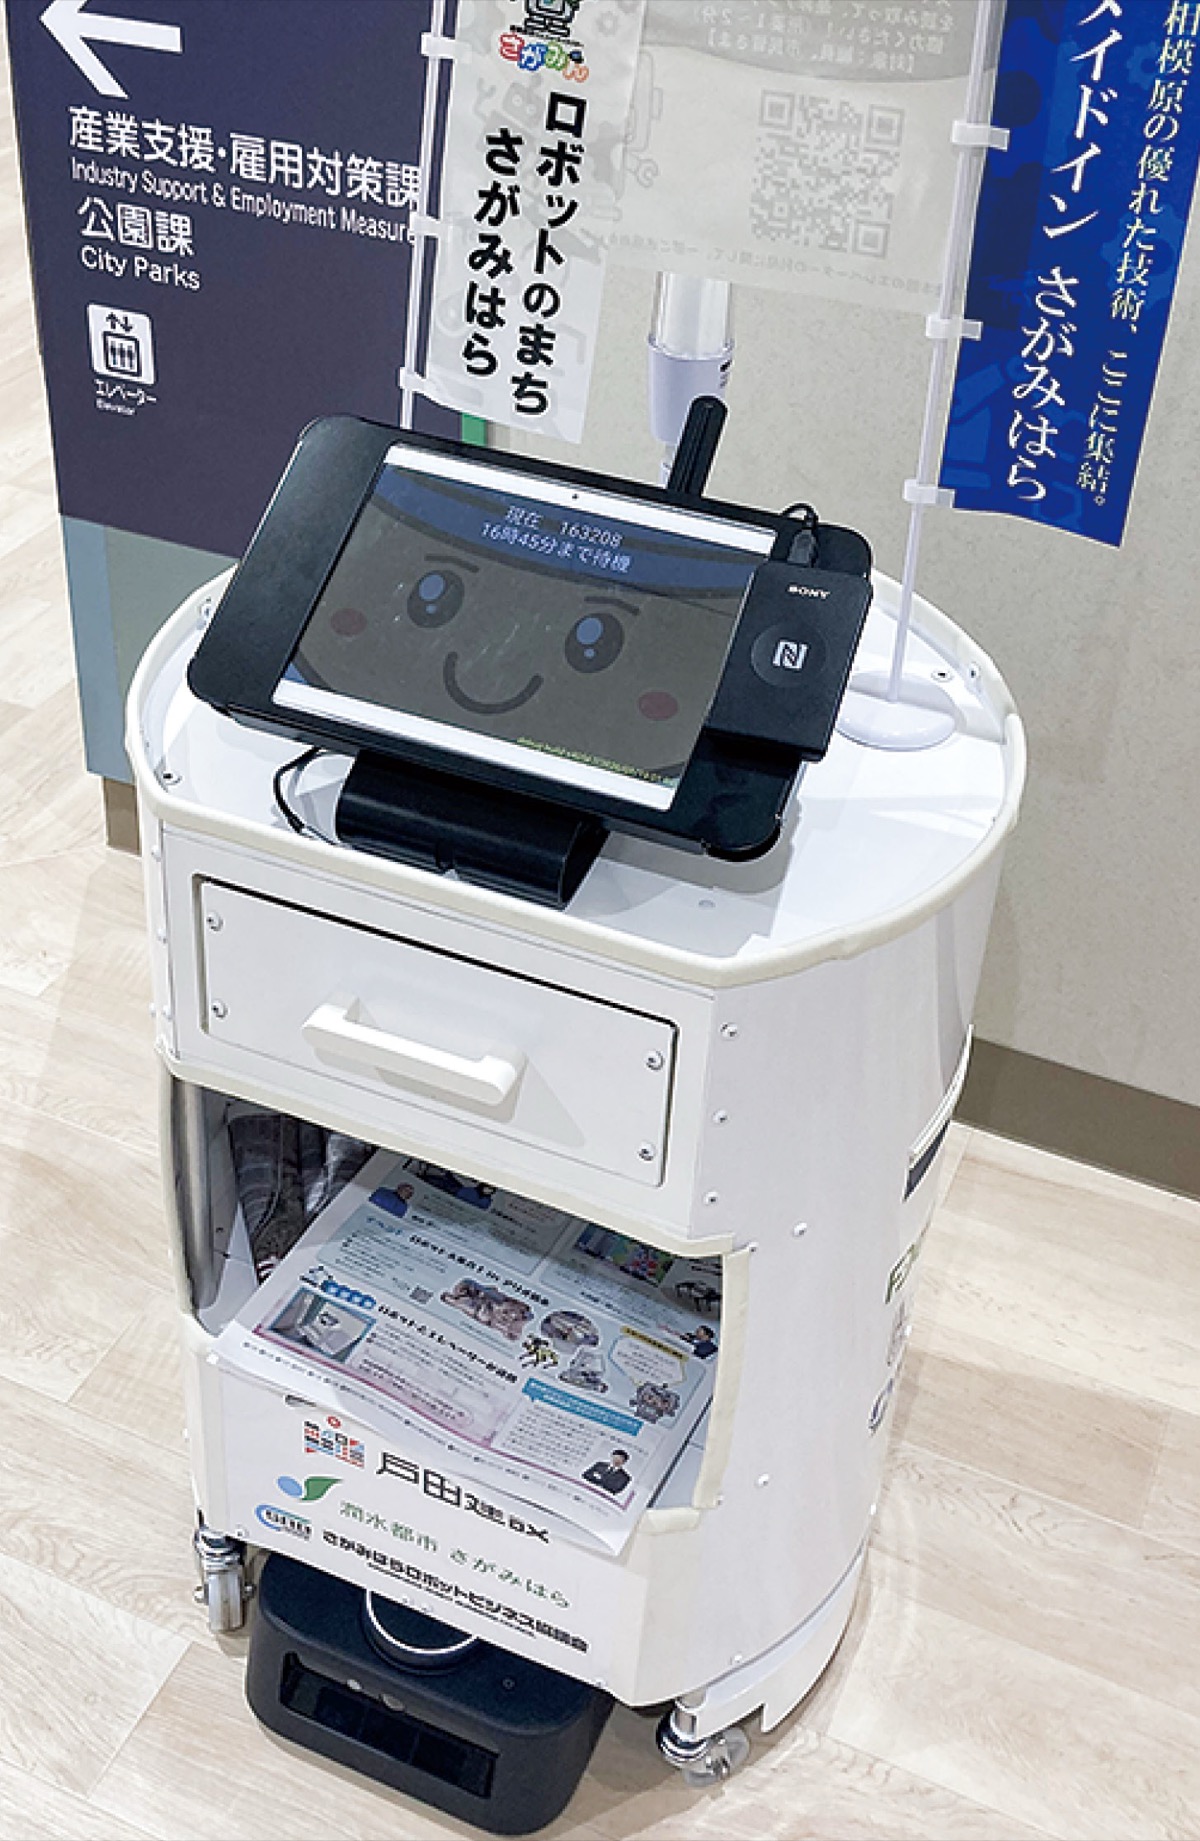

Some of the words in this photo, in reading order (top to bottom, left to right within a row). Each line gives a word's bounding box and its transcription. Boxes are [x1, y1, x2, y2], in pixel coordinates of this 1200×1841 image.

[71, 156, 138, 194] Industry
[141, 168, 208, 205] Support
[211, 182, 226, 208] &
[231, 186, 337, 230] Employment
[77, 196, 195, 257] 公園課
[80, 245, 128, 278] City
[134, 256, 201, 290] Parks
[462, 127, 524, 377] さがみはら
[510, 91, 587, 415] ロボットのまち
[94, 379, 157, 406] エレベーター
[1007, 266, 1079, 501] さがみはら
